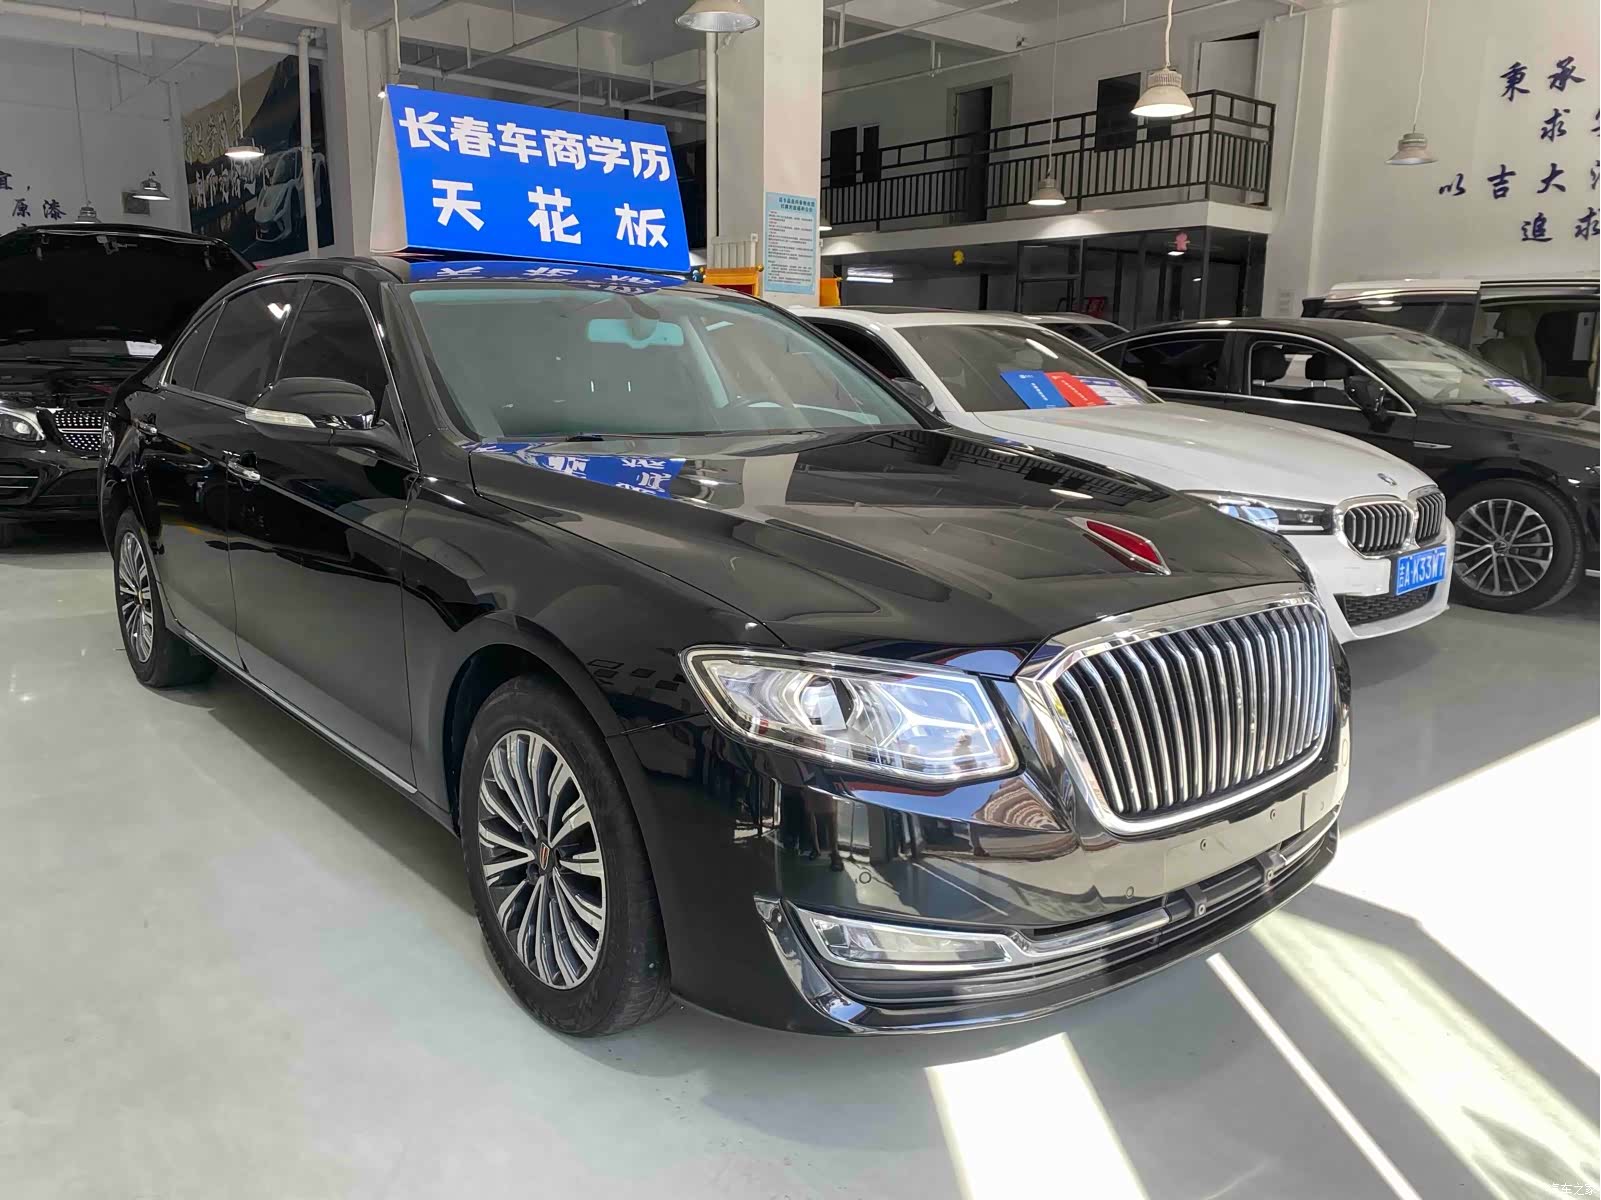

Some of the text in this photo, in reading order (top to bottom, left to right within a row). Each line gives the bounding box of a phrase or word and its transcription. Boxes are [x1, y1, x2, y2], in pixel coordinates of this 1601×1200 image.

[1500, 56, 1586, 102] 秉承
[399, 107, 671, 182] 长春车商学历
[12, 198, 67, 220] 原漆
[432, 179, 669, 248] 天花板
[1521, 207, 1600, 242] 追求
